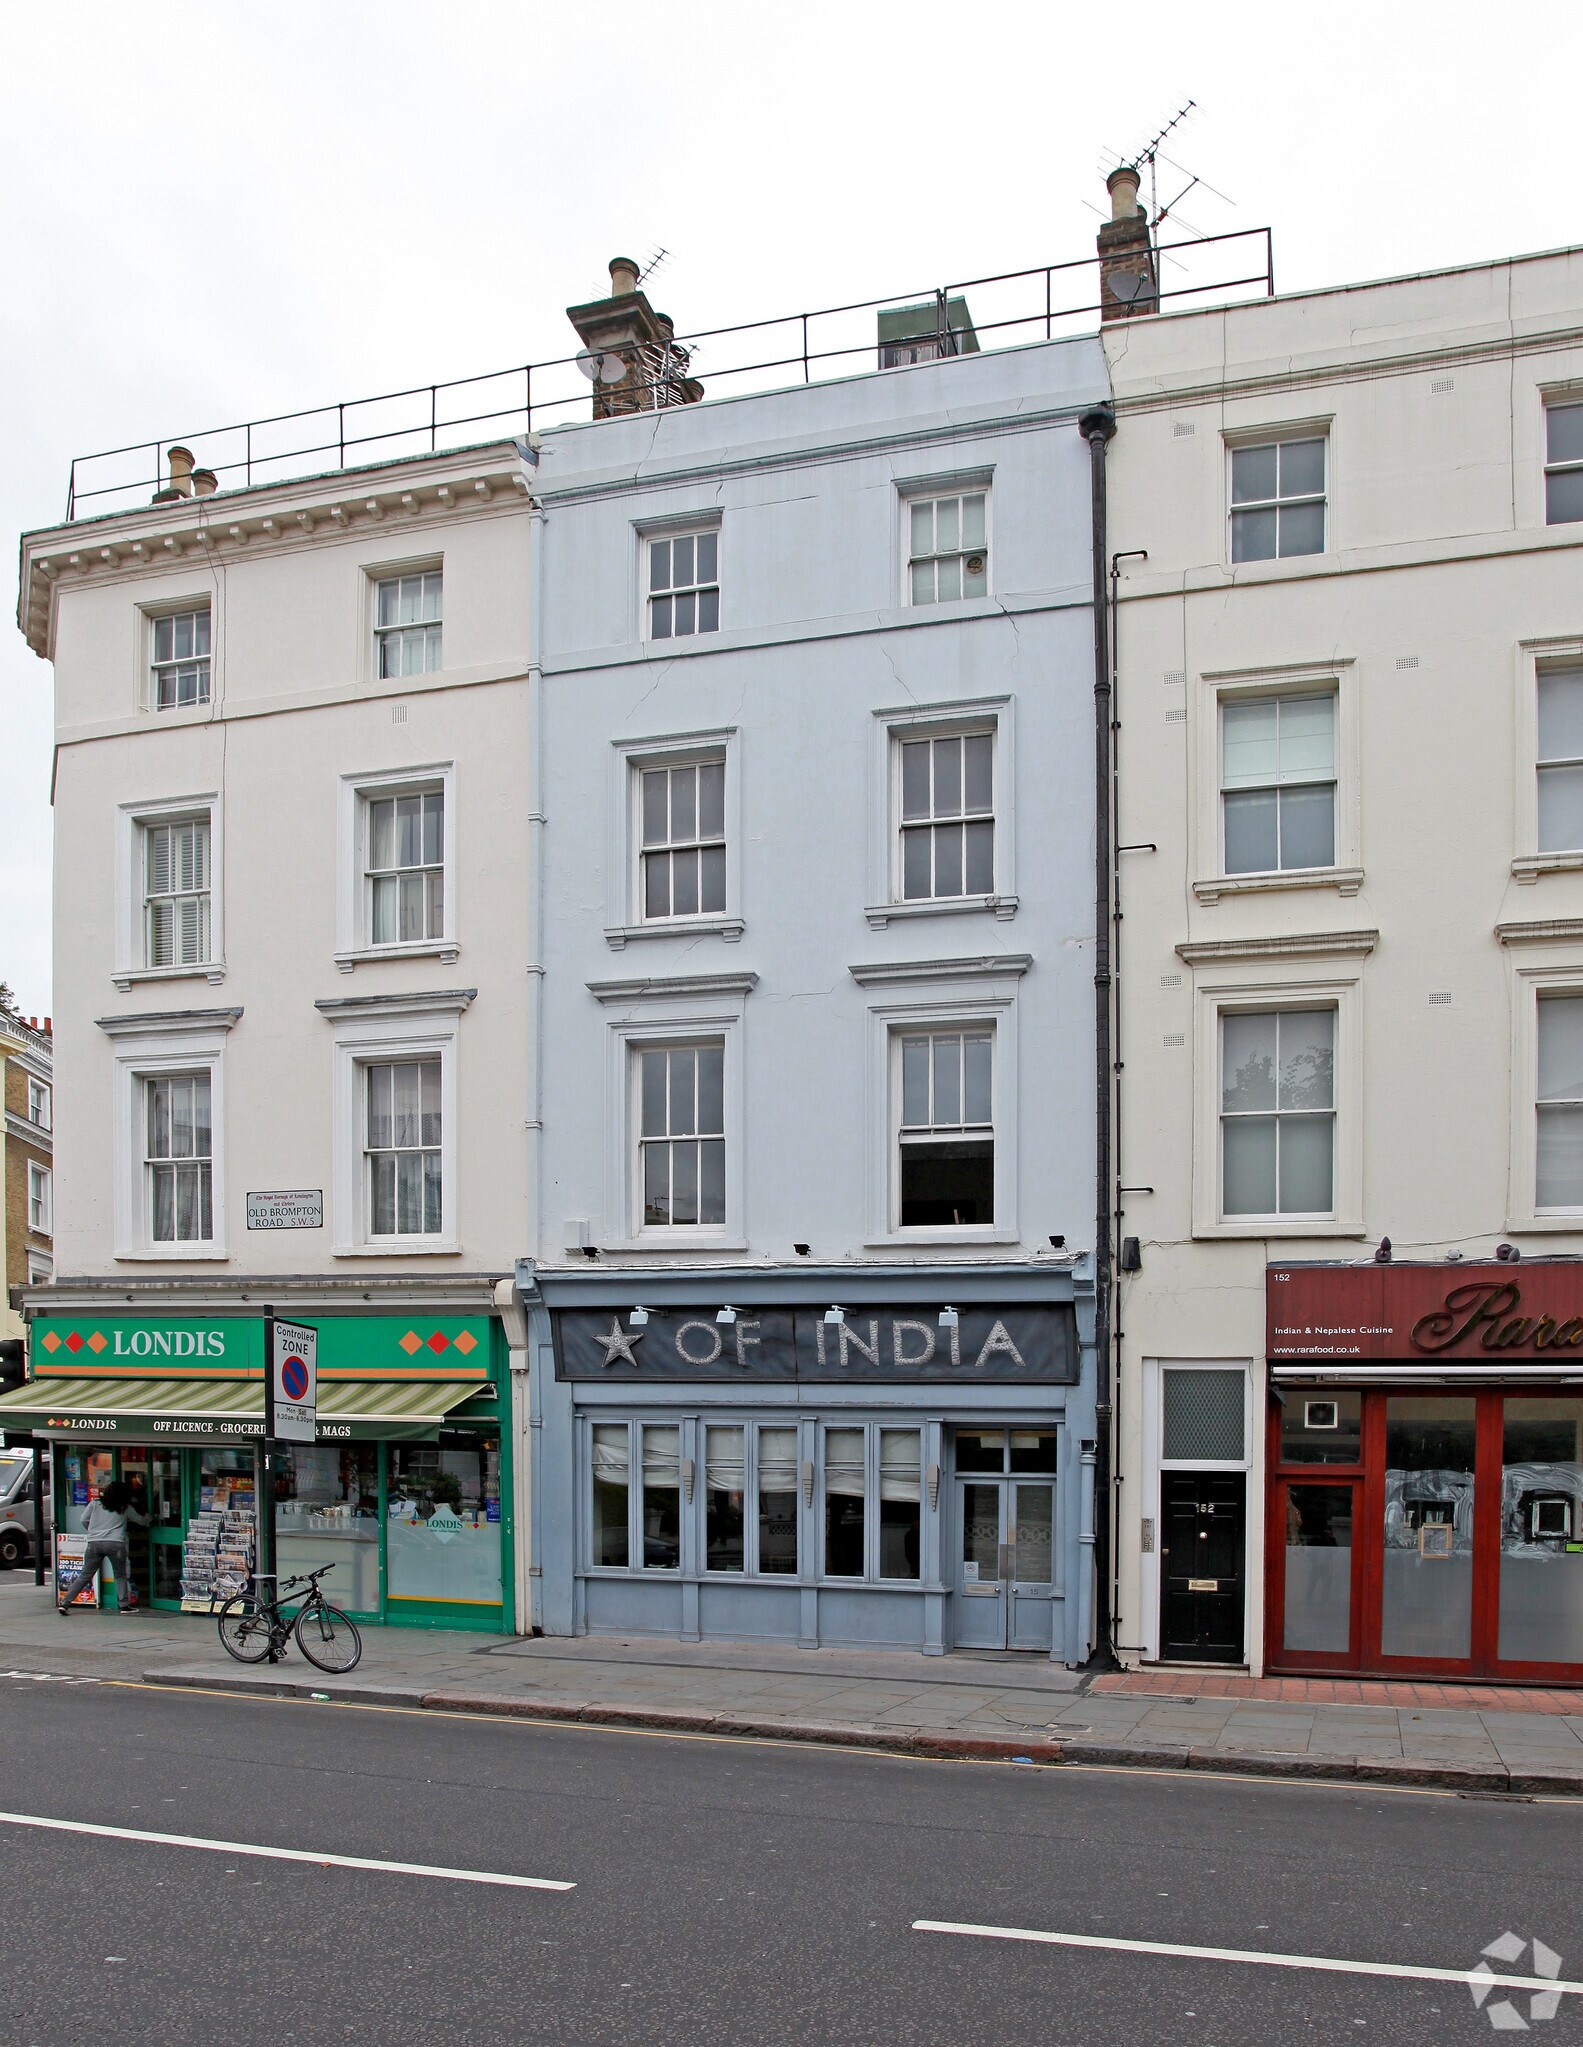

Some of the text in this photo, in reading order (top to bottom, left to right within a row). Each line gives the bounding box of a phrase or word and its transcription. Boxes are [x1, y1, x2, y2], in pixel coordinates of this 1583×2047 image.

[248, 1207, 321, 1217] OLD BROMPTON
[1274, 1274, 1290, 1282] 152
[276, 1325, 315, 1342] Controlled
[1315, 1326, 1356, 1336] Nepalese
[1360, 1326, 1394, 1334] Cuisine
[113, 1330, 226, 1357] LONDIS
[282, 1339, 308, 1355] ZONE
[674, 1320, 1026, 1366] OF INDIA
[1274, 1345, 1360, 1354] www.rarafood.co.uk
[70, 1418, 117, 1430] LONDIS
[154, 1421, 172, 1431] OFF
[173, 1422, 214, 1433] LICENCE
[322, 1426, 351, 1436] MAGS
[1195, 1503, 1215, 1513] 152
[426, 1519, 463, 1529] LONDIS
